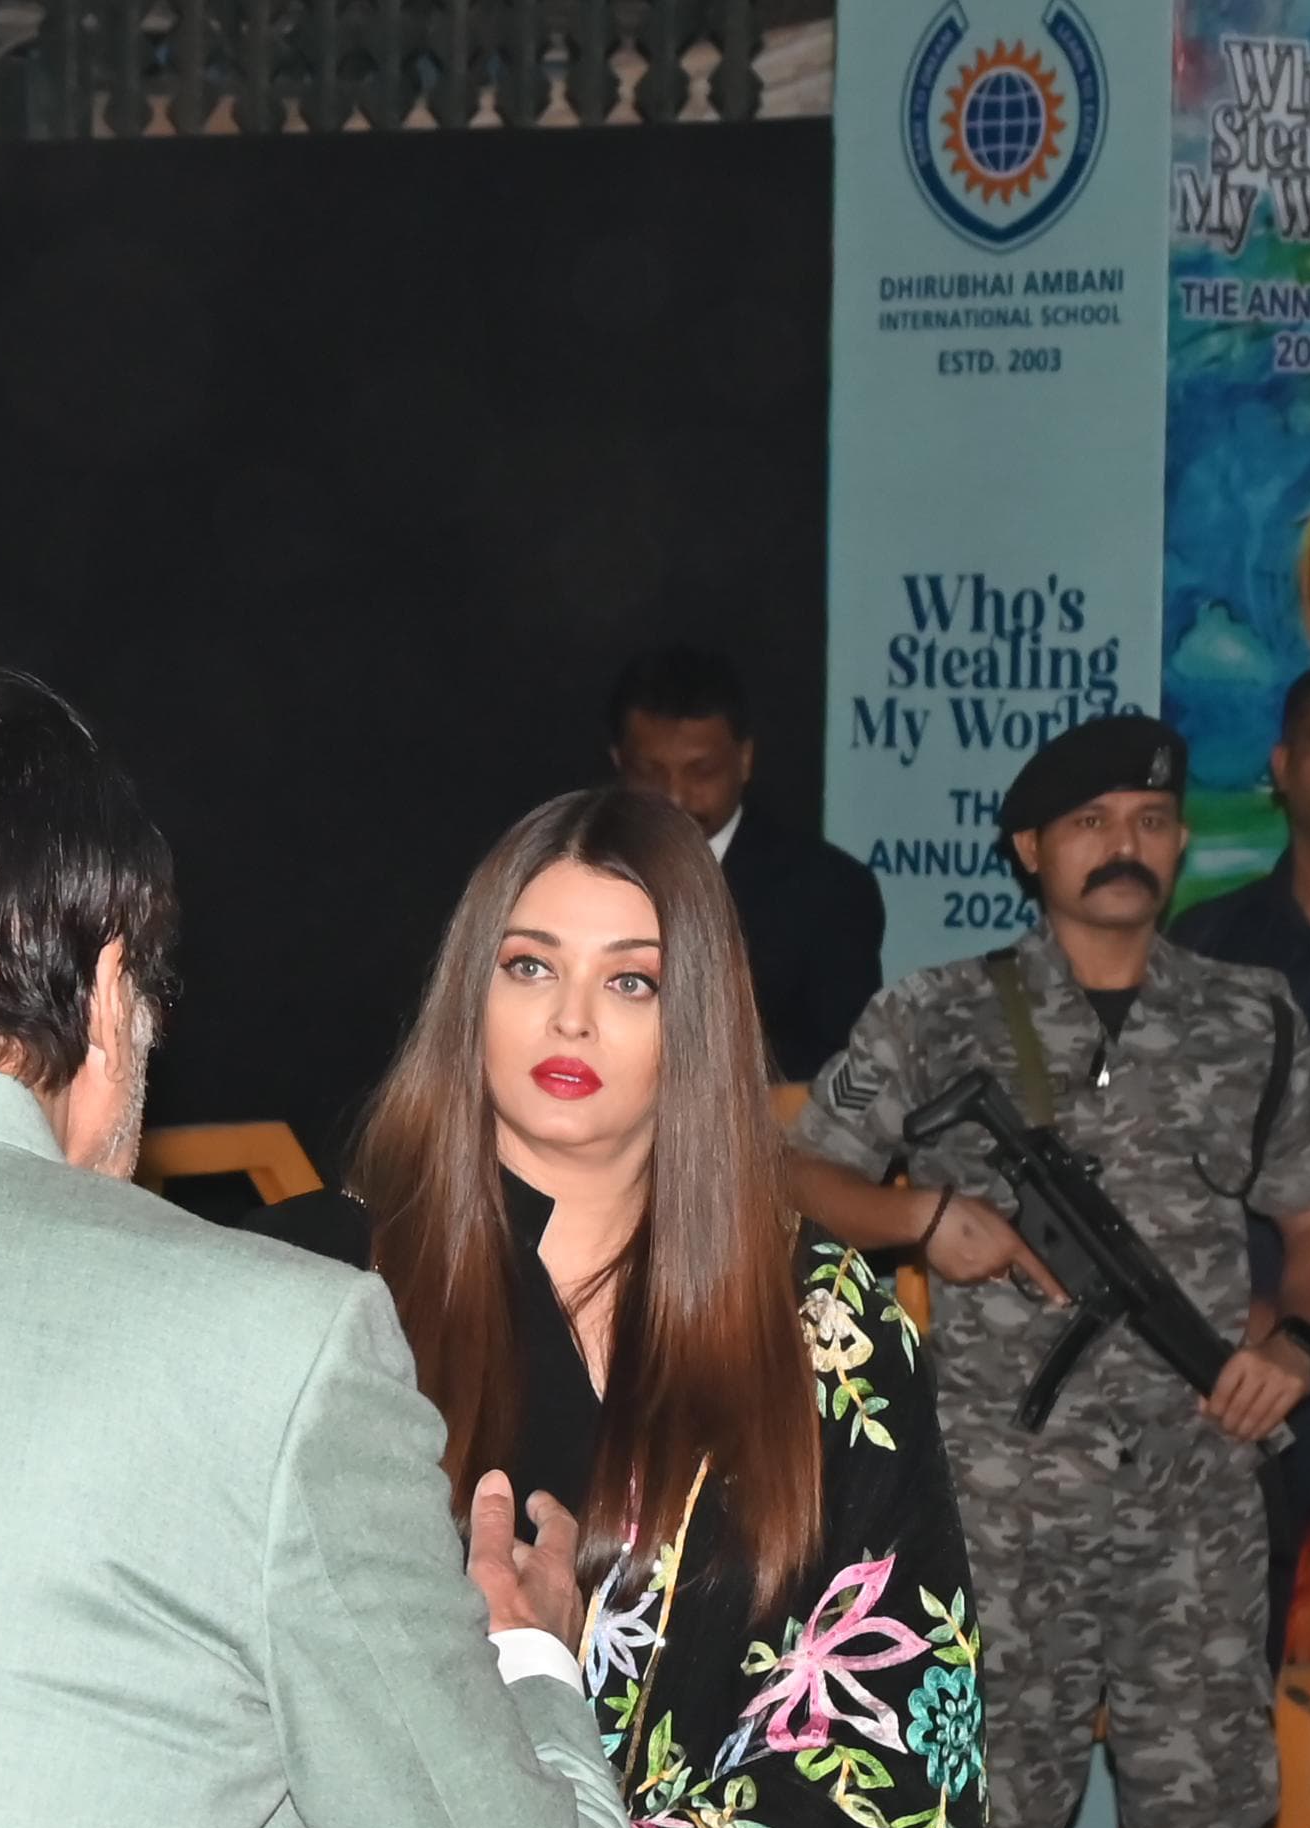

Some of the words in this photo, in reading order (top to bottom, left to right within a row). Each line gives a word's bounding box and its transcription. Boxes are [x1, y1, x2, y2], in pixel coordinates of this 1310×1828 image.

[1177, 169, 1258, 255] My
[879, 273, 1014, 301] DHIRUBHAI
[1024, 268, 1124, 295] AMBANI
[1180, 282, 1239, 316] THE
[878, 307, 1033, 331] INTERNATIONAL
[1041, 303, 1121, 327] SCHOOL
[938, 349, 1001, 375] ESTD.
[1009, 347, 1062, 373] 2003
[902, 573, 1086, 640] Who's
[888, 627, 1120, 706] Stealing
[851, 696, 930, 768] My
[948, 695, 1145, 750] Worl
[867, 840, 1012, 878] ANNUA
[943, 891, 1038, 929] 2024
